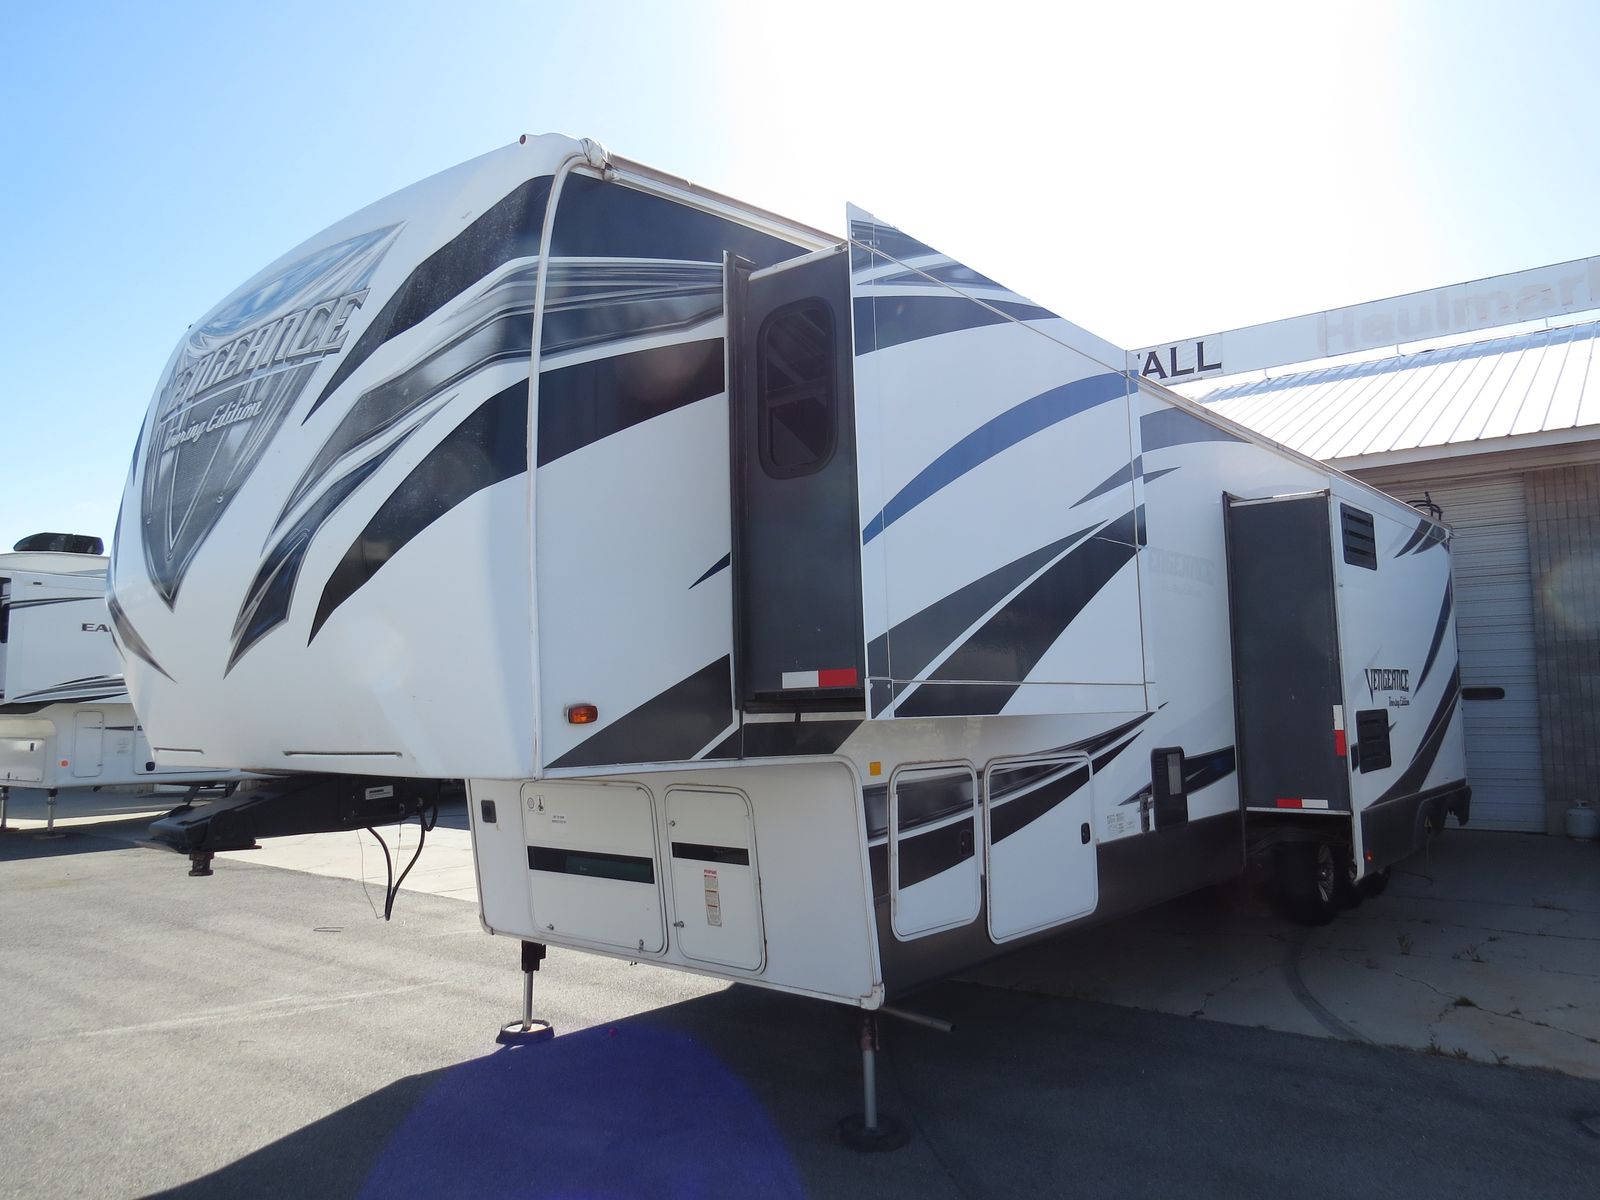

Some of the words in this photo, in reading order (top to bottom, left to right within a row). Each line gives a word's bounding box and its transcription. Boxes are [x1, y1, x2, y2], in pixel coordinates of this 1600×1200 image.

[1137, 341, 1222, 379] ALL
[206, 400, 264, 434] Edition
[81, 623, 112, 633] EA
[1364, 668, 1409, 704] VENGEANCE
